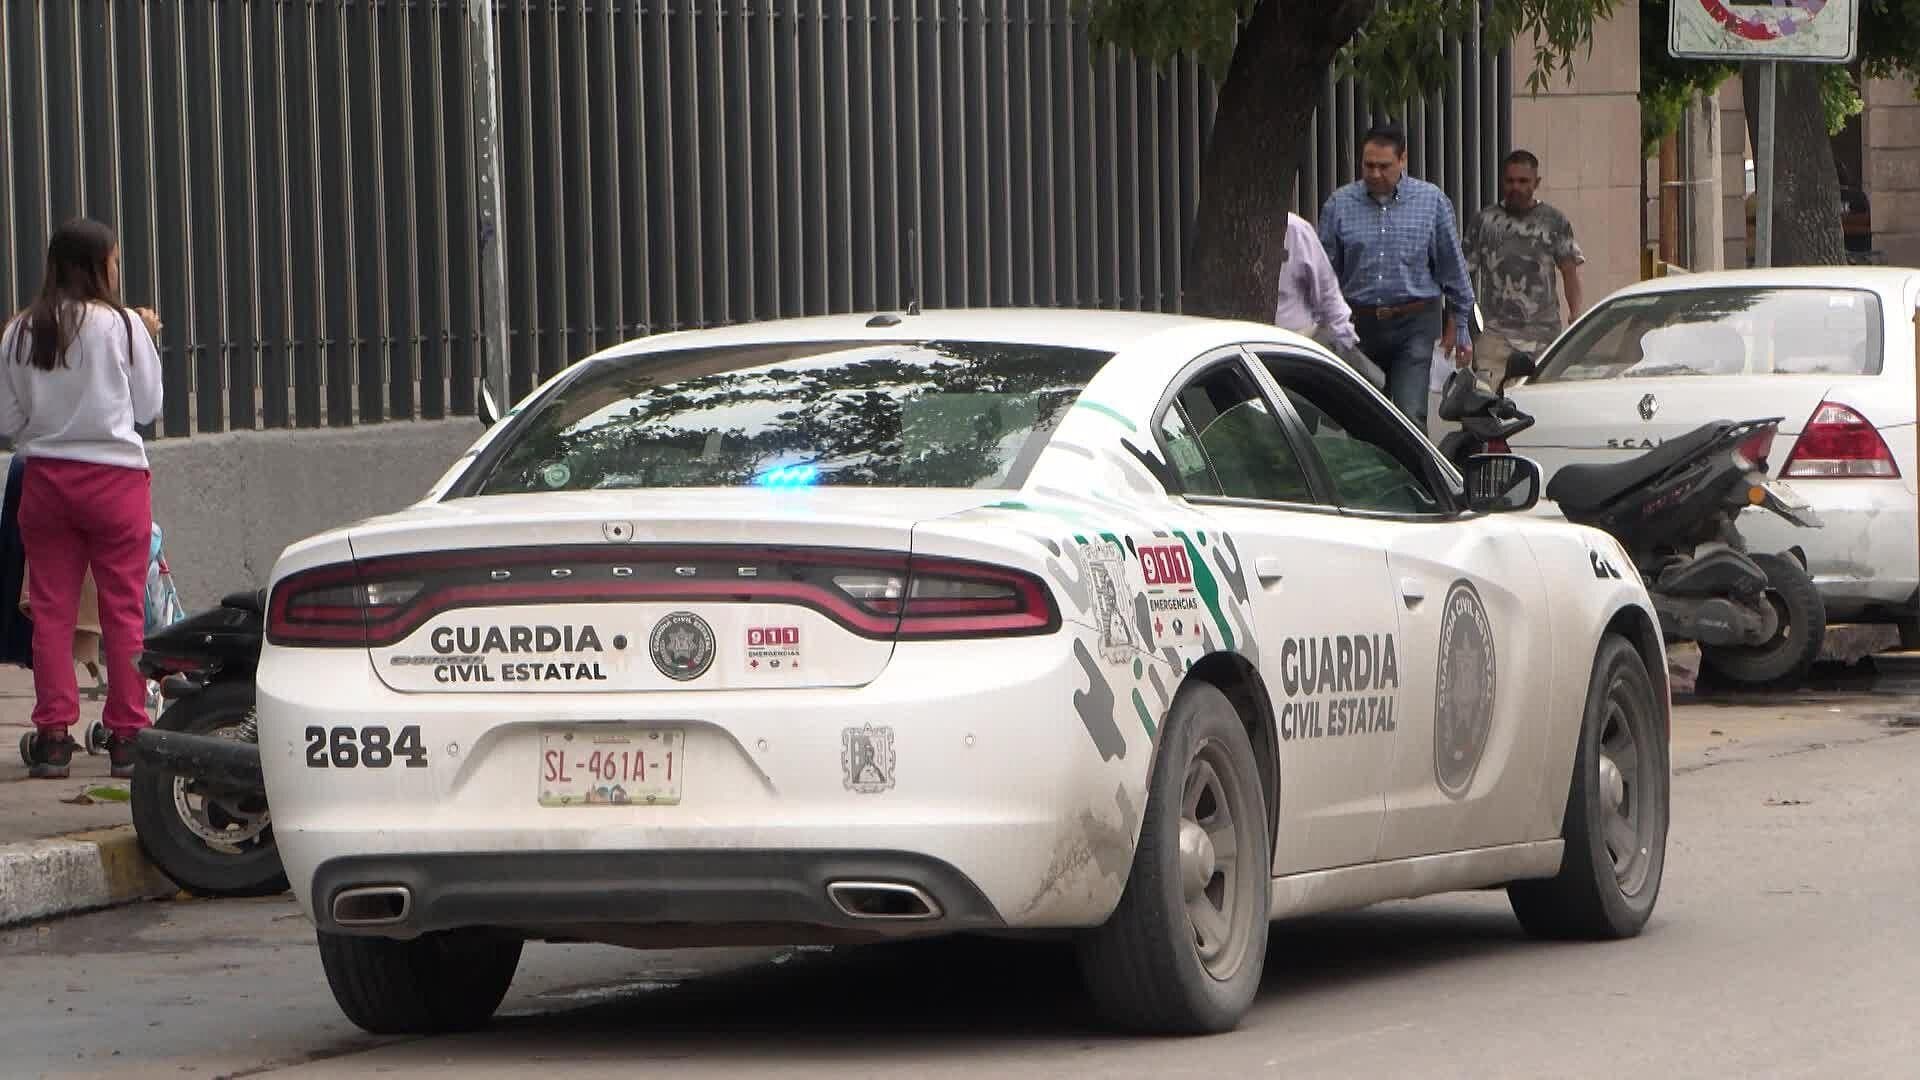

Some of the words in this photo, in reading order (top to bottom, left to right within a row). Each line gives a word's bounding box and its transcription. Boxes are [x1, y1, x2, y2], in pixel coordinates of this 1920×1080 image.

[491, 567, 758, 579] DODGE
[1142, 550, 1188, 582] 911
[1150, 598, 1198, 611] EMERGENCIAS
[430, 625, 604, 654] GUARDIA
[750, 630, 796, 643] 911
[434, 663, 495, 682] CIVIL
[501, 663, 608, 681] ESTATAL
[1281, 633, 1399, 697] GUARDIA
[1281, 701, 1322, 741] CIVIL
[1327, 695, 1396, 737] ESTATAL
[305, 725, 428, 768] 2684
[544, 749, 673, 782] SL-461A-1
